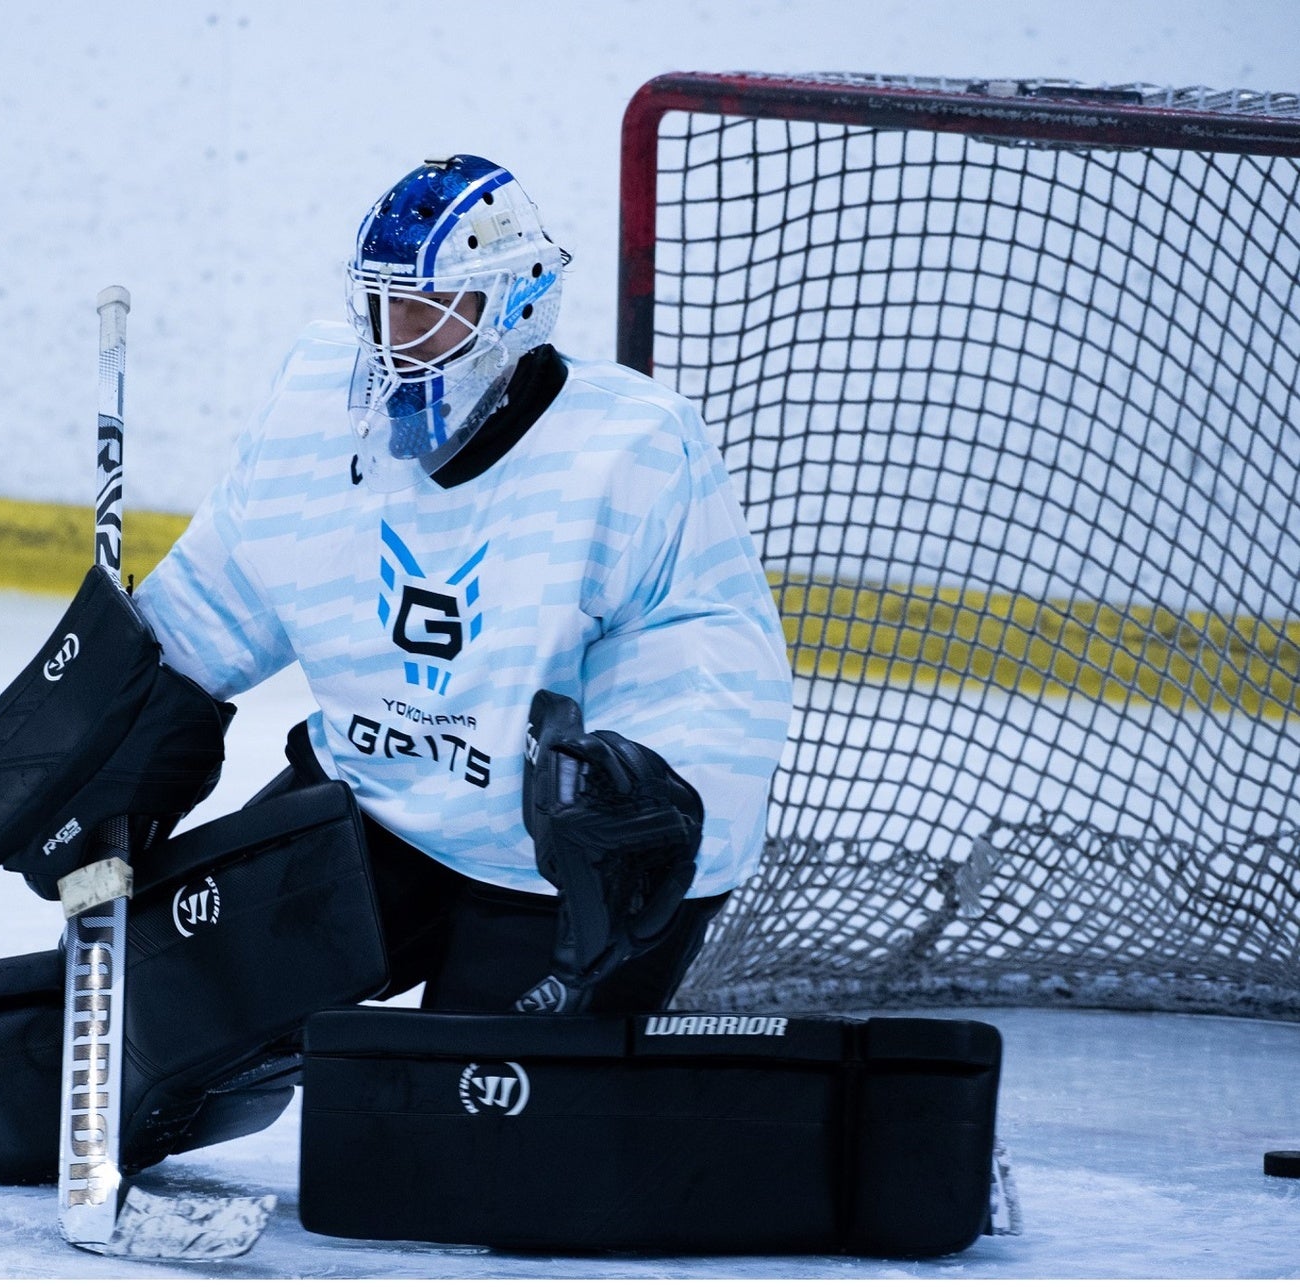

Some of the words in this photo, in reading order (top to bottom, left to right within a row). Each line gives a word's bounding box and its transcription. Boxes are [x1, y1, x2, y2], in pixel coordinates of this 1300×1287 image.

[393, 585, 462, 661] G
[382, 698, 476, 730] YOKOHAMA
[349, 714, 490, 789] GRITS
[645, 1016, 788, 1036] WARRIOR
